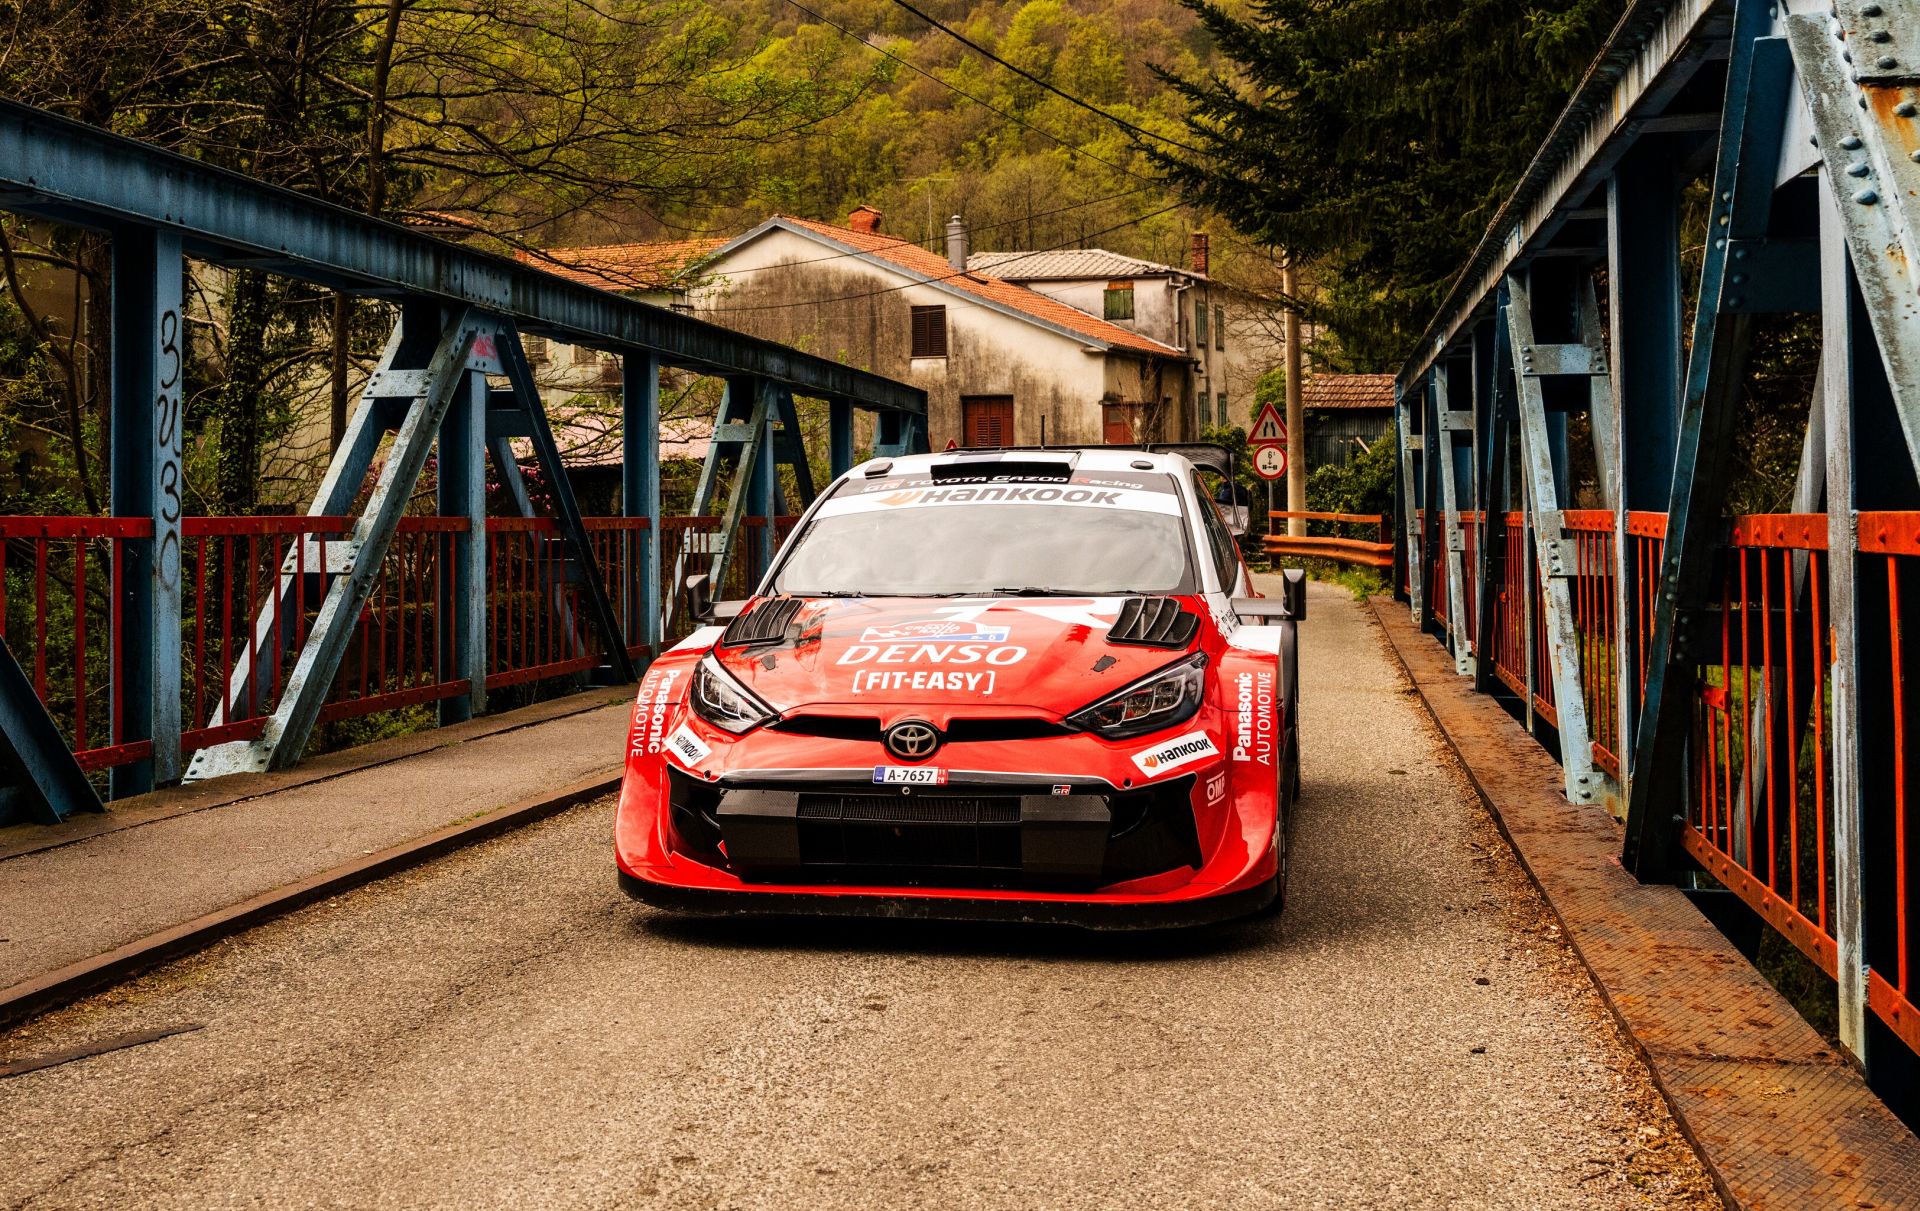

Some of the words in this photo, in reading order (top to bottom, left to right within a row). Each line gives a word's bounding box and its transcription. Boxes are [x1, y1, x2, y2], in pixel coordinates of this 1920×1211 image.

[906, 475, 987, 486] TOYOTA
[989, 474, 1068, 484] GAZOO
[1071, 476, 1144, 490] Racing
[835, 644, 1028, 666] DENSO
[631, 669, 661, 757] AUTOMOTIVE
[647, 669, 682, 754] Panasonic
[1232, 672, 1253, 762] Panasonic
[1256, 671, 1272, 766] AUTOMOTIVE
[887, 769, 934, 782] A-7657
[1206, 775, 1226, 801] OMP
